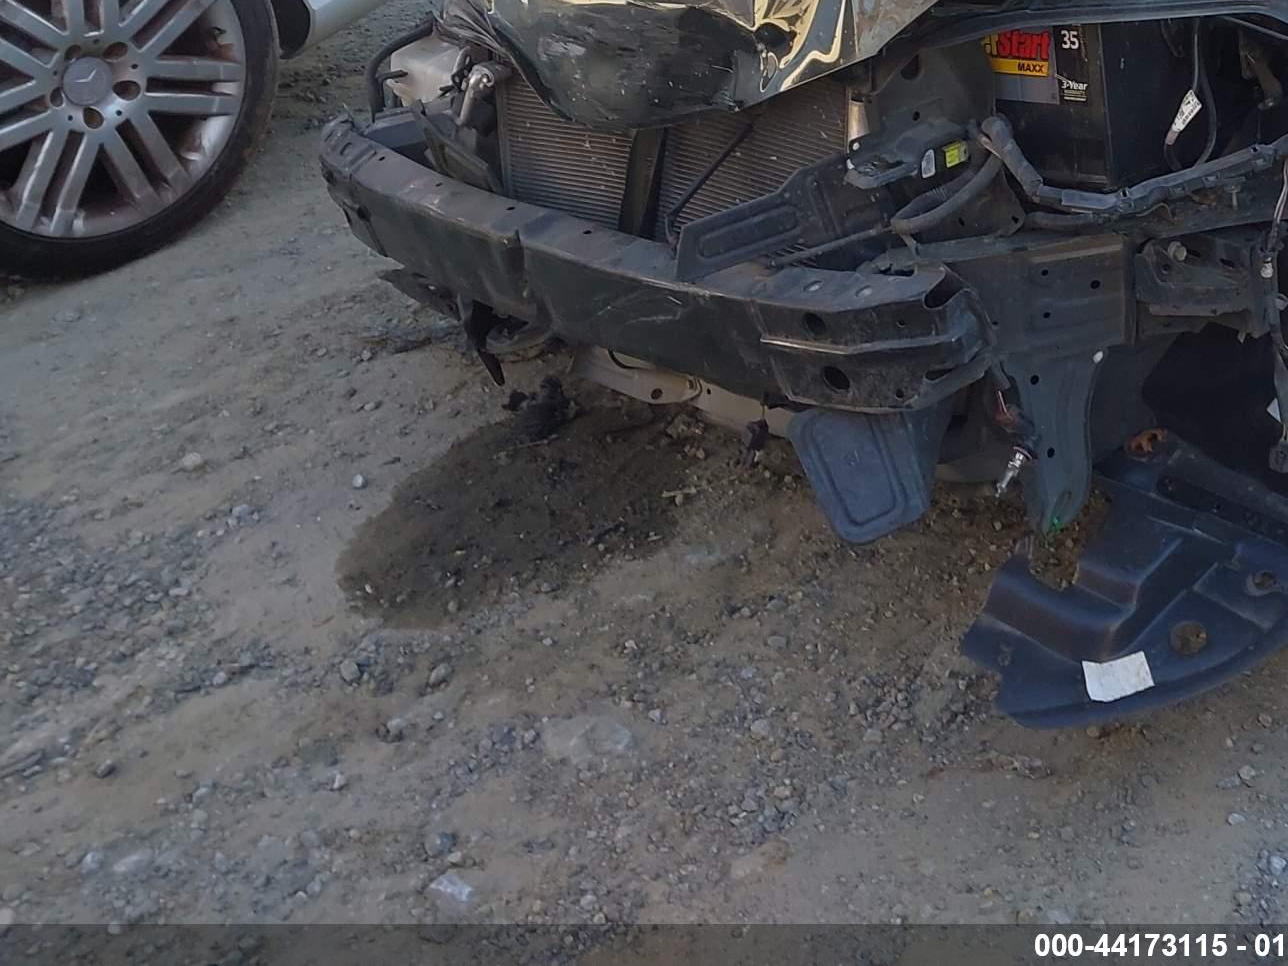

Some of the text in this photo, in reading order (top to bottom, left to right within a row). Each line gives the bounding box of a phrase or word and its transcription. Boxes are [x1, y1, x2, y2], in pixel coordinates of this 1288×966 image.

[1060, 30, 1079, 49] 35
[1018, 62, 1044, 73] MAXX
[1061, 80, 1088, 90] 3-Year
